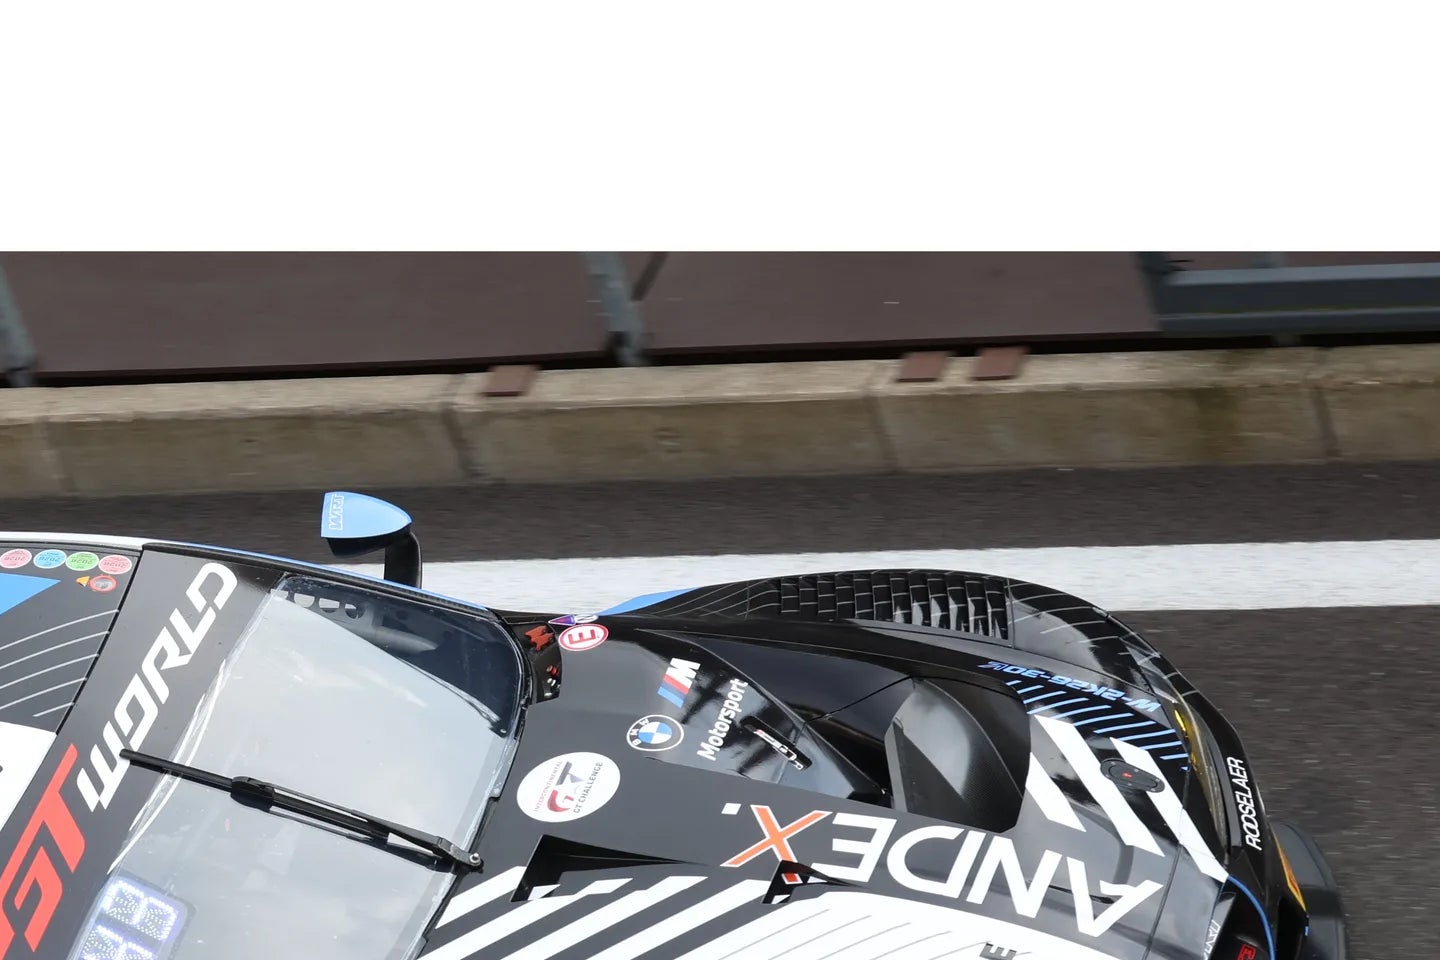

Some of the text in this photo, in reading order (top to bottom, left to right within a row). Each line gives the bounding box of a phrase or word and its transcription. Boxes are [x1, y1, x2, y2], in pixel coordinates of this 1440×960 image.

[568, 629, 595, 645] E
[76, 562, 237, 812] WORLD
[697, 677, 749, 761] Motorsport
[572, 761, 604, 814] GT CHALLENGE
[1226, 756, 1263, 850] ROOSELAER
